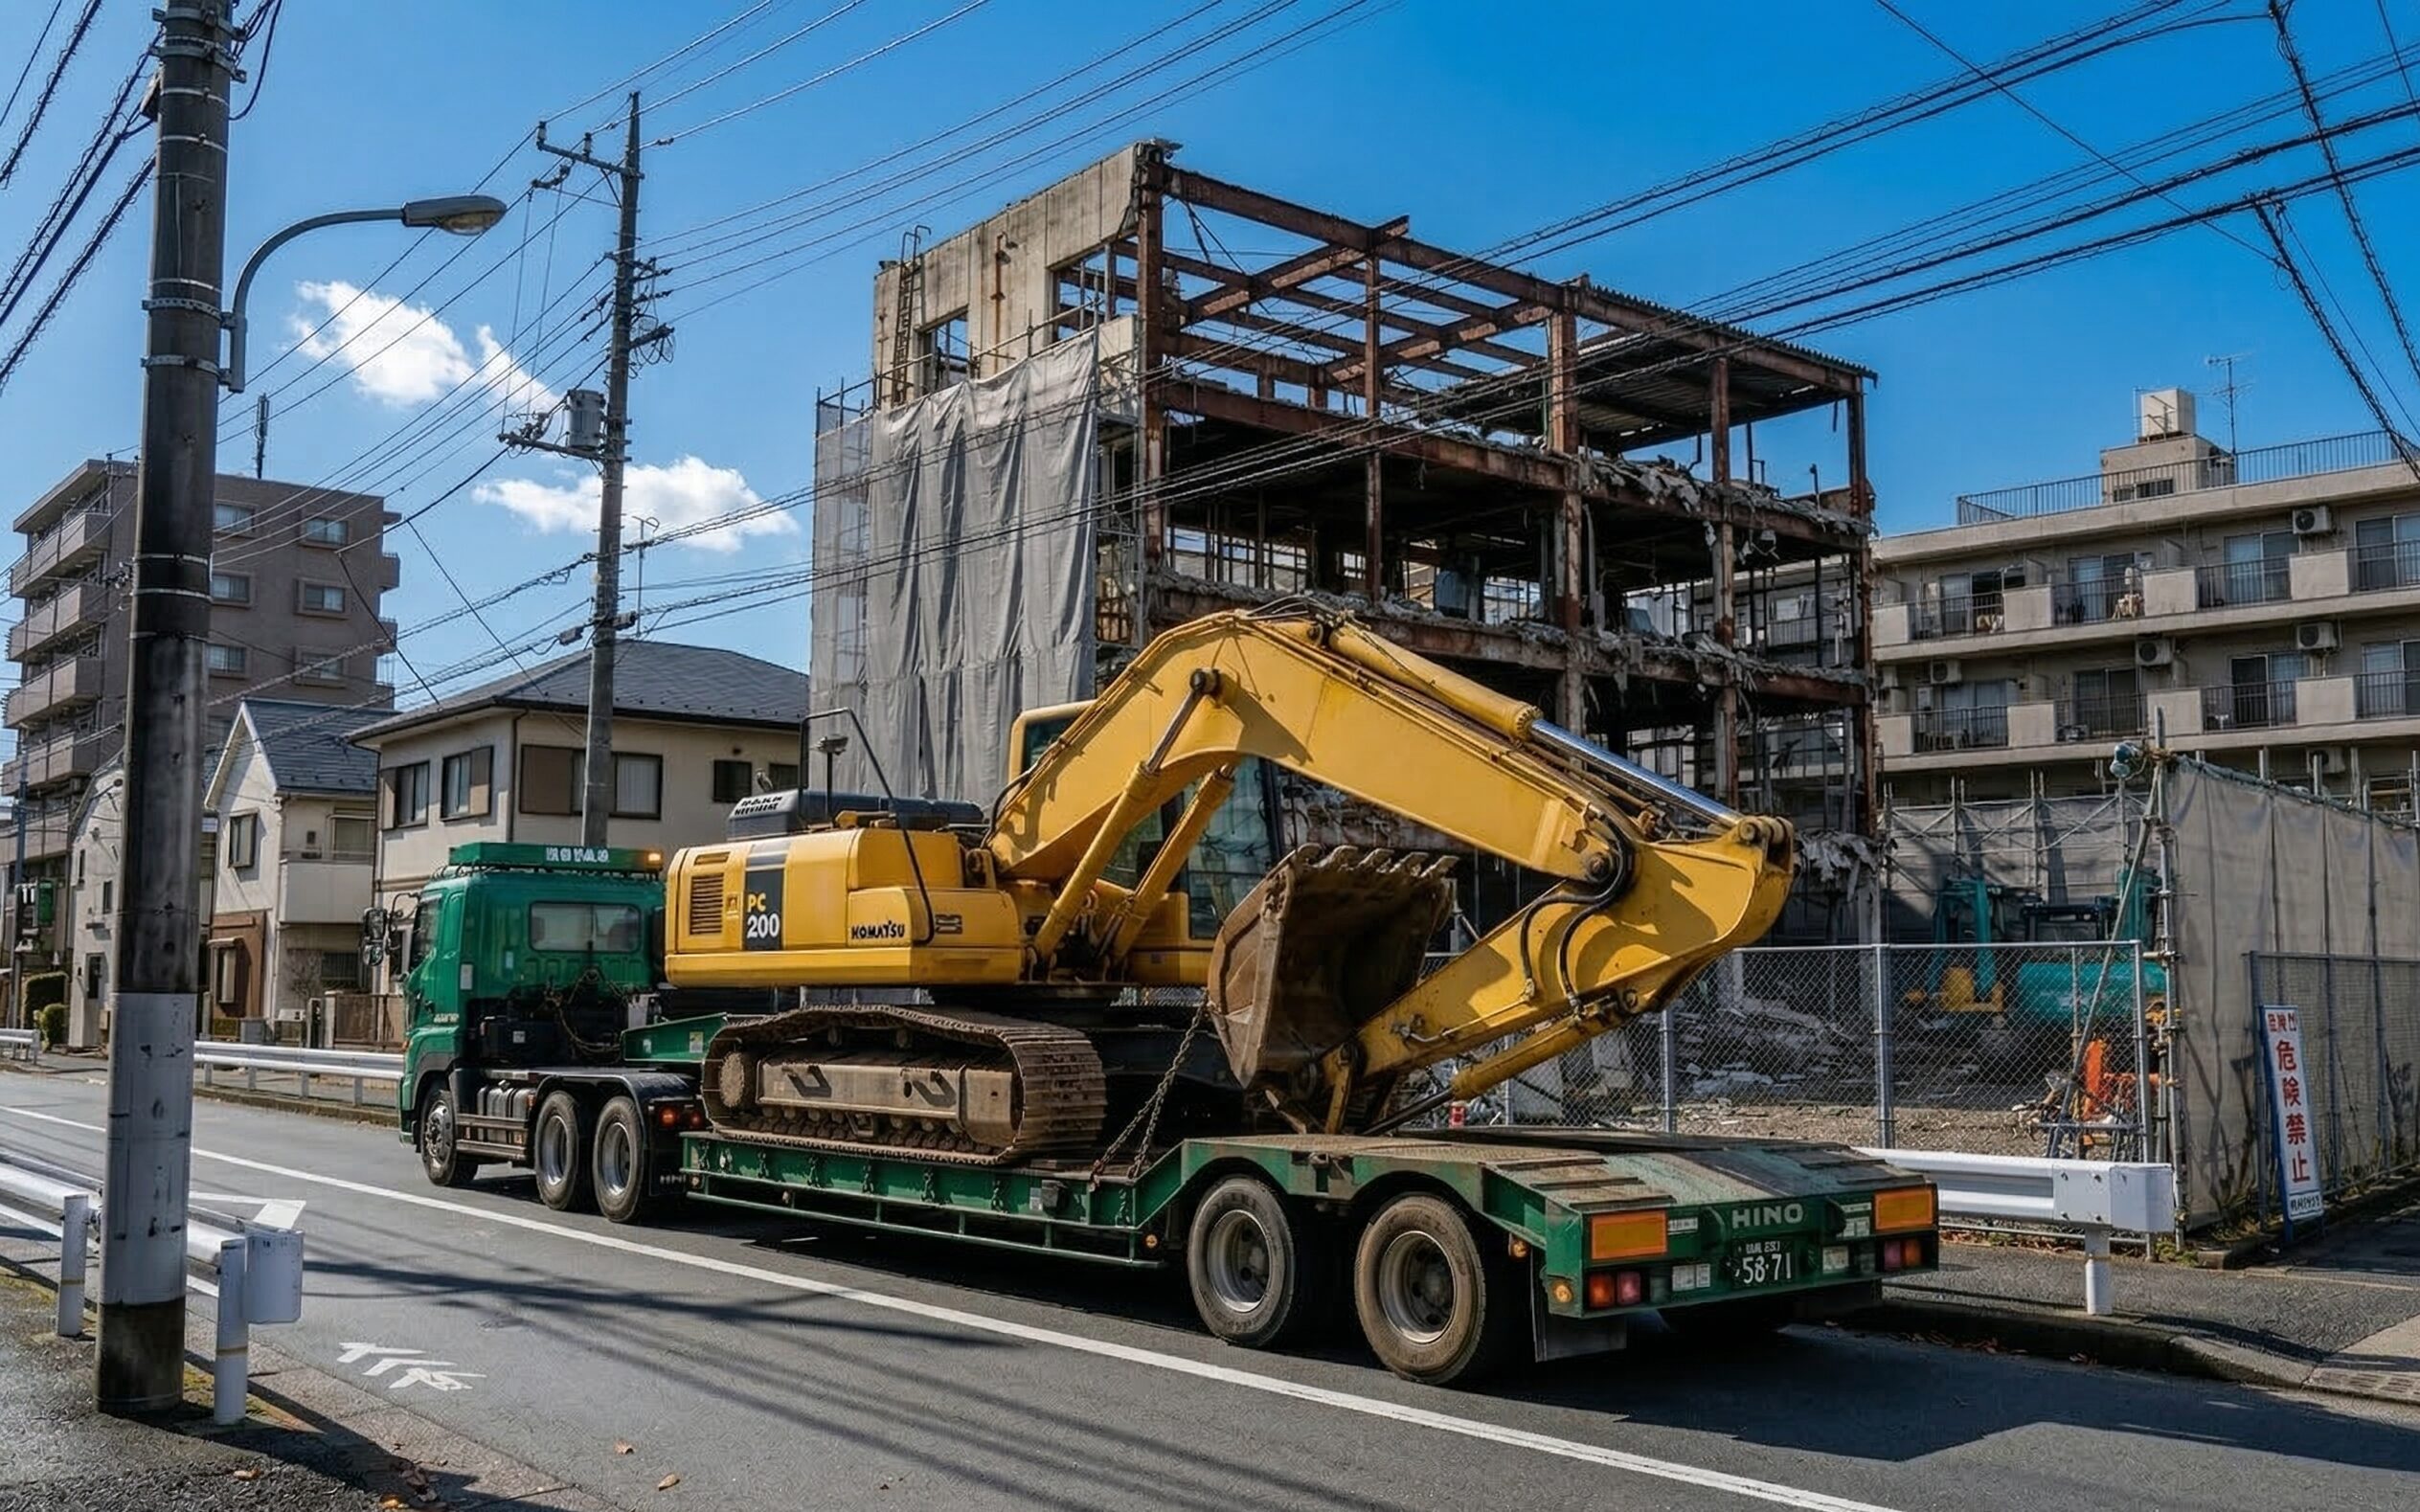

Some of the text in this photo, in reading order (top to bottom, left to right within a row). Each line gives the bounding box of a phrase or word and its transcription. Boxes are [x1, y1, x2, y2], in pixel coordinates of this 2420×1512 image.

[747, 892, 766, 913] PC
[746, 913, 780, 939] 200
[851, 920, 905, 939] KOMATSU
[2275, 1039, 2311, 1184] 危険禁止
[1731, 1203, 1804, 1230] HINO
